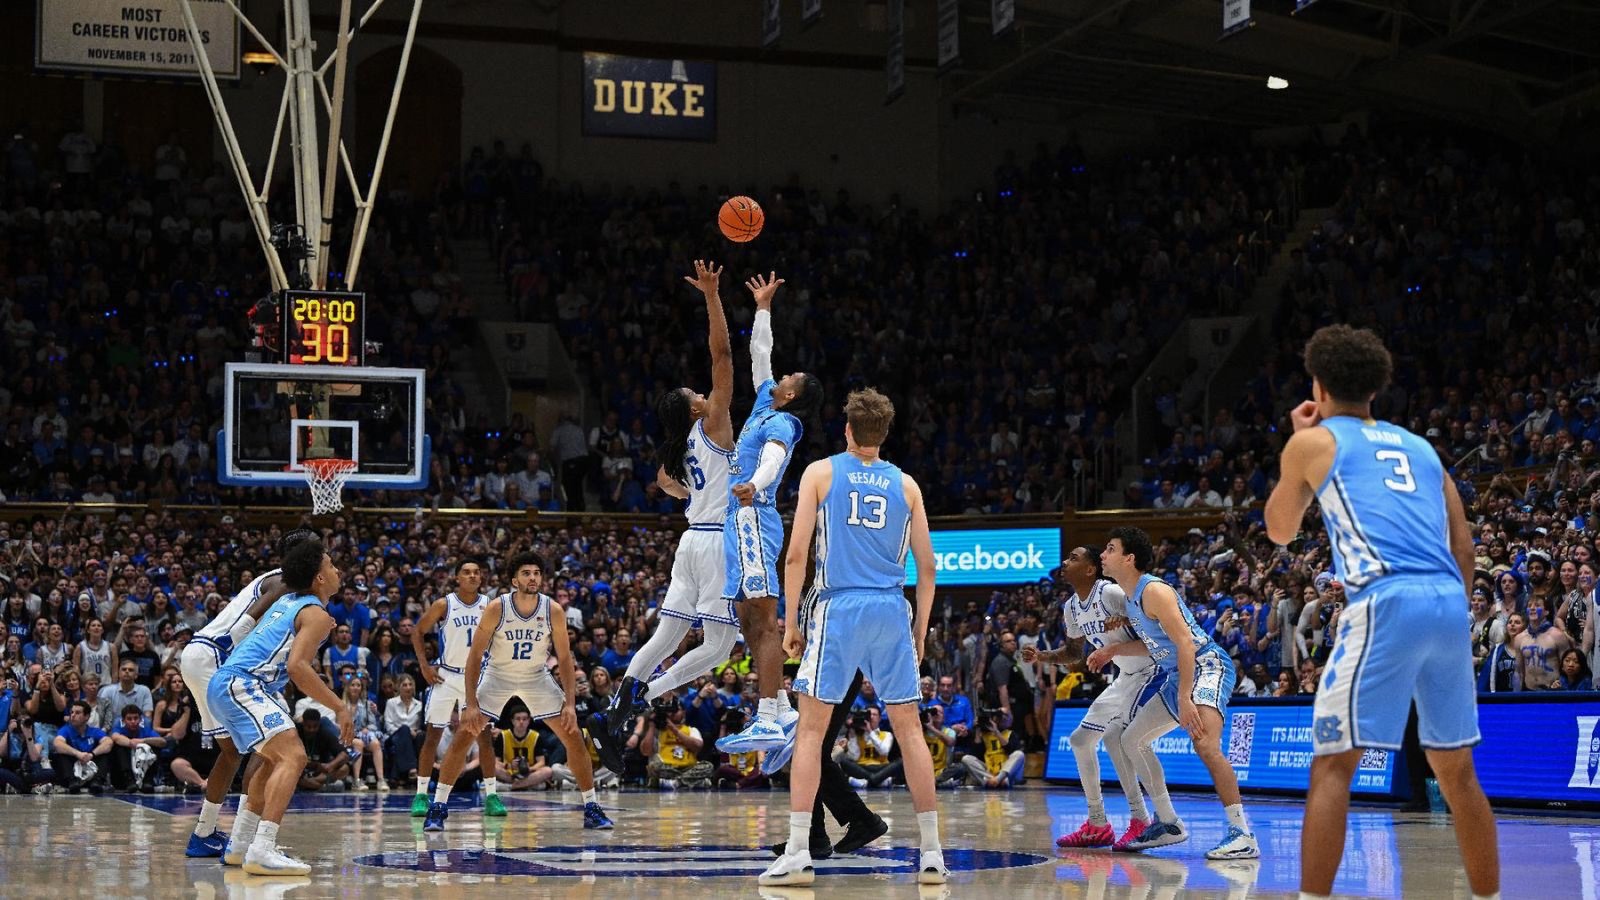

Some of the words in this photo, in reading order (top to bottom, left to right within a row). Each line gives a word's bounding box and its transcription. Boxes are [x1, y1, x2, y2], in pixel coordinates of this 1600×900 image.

[121, 8, 162, 23] MOST
[72, 23, 129, 39] CAREER
[135, 27, 210, 44] VICTORS
[88, 49, 146, 61] NOVEMBER
[150, 53, 166, 64] 15,
[169, 53, 195, 64] 2011
[593, 79, 705, 118] DUKE
[294, 300, 355, 322] 20:00
[302, 323, 349, 363] 30
[1375, 449, 1418, 493] 3
[847, 472, 890, 490] VEESAAR
[847, 490, 888, 530] 13
[934, 542, 1044, 571] acebook
[453, 615, 479, 628] DUK
[504, 629, 544, 642] DUKE
[512, 642, 534, 660] 12
[1268, 751, 1279, 768] IN
[1279, 751, 1314, 768] FACEBOO
